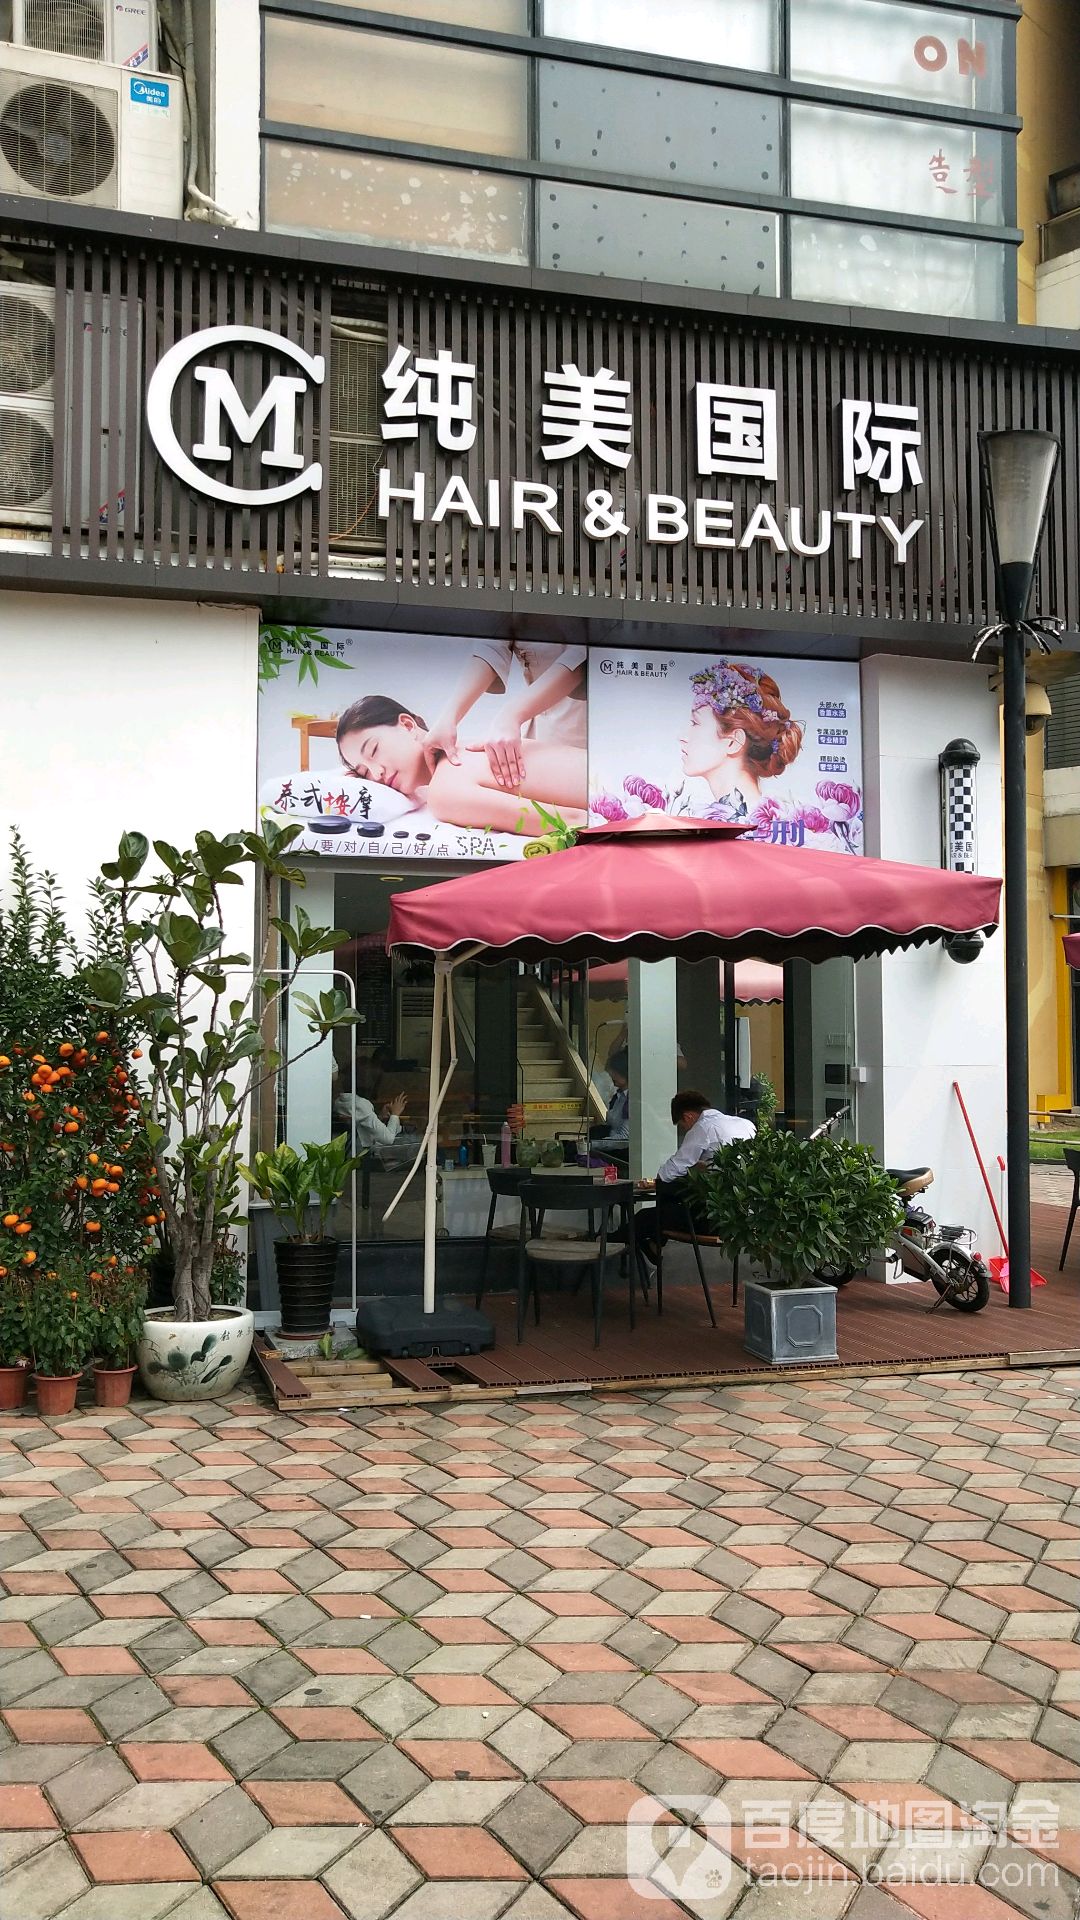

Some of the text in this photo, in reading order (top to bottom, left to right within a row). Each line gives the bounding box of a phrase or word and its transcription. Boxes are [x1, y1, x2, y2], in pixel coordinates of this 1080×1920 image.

[914, 35, 987, 80] ON
[133, 81, 166, 98] Midea
[929, 149, 994, 198] 造型
[380, 346, 923, 494] 纯美国际
[378, 467, 925, 565] HAIR & BEAUTY
[616, 660, 668, 672] 纯美国际
[640, 670, 669, 678] BEAUTY
[275, 780, 373, 819] 泰式按摩
[456, 835, 496, 857] SPA
